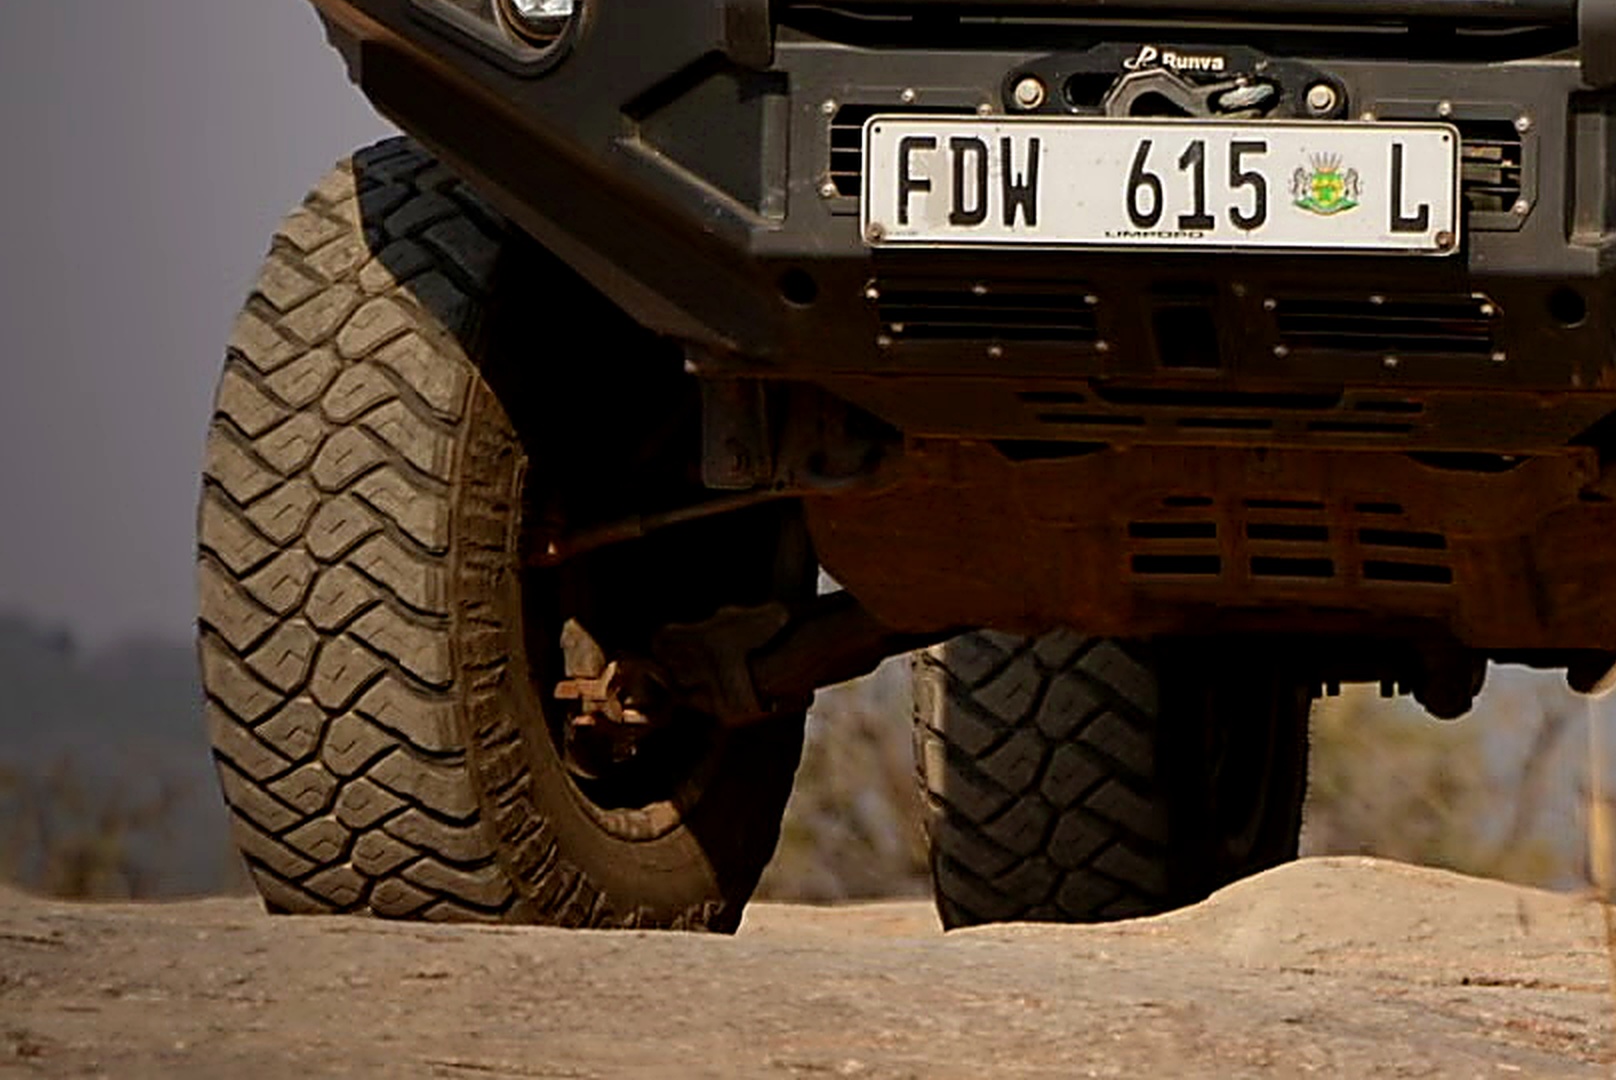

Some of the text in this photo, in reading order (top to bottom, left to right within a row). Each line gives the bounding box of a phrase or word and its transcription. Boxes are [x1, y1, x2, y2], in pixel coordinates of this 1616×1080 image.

[897, 136, 1430, 233] FDW 615 L
